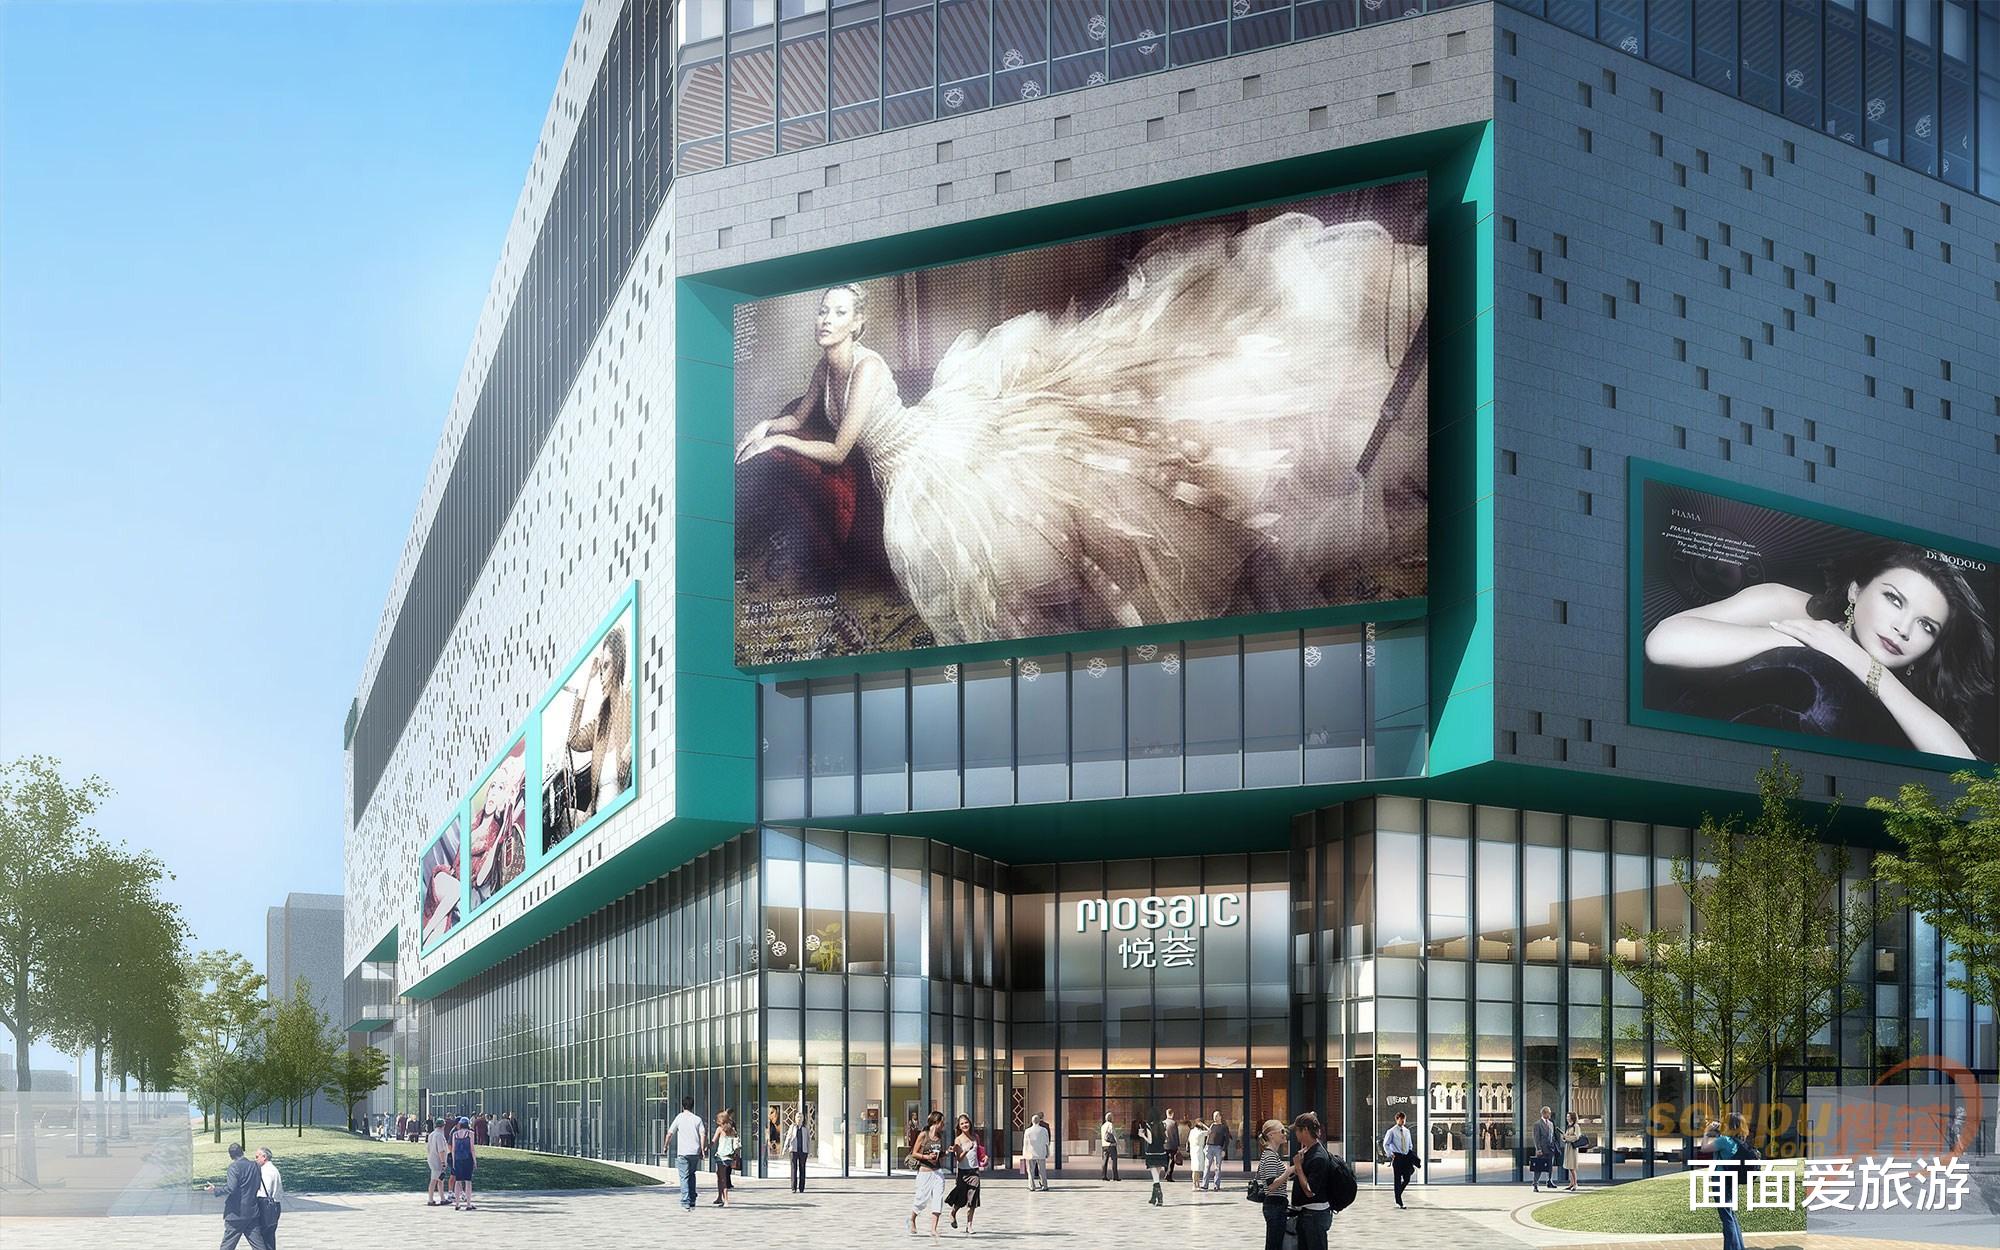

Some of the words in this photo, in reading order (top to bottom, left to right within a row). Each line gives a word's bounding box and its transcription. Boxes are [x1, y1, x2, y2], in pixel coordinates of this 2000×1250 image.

[1671, 508, 1702, 521] FIAMA
[1925, 550, 1937, 560] Di
[1939, 552, 1987, 572] MODOLO
[1118, 929, 1198, 969] 悦荟
